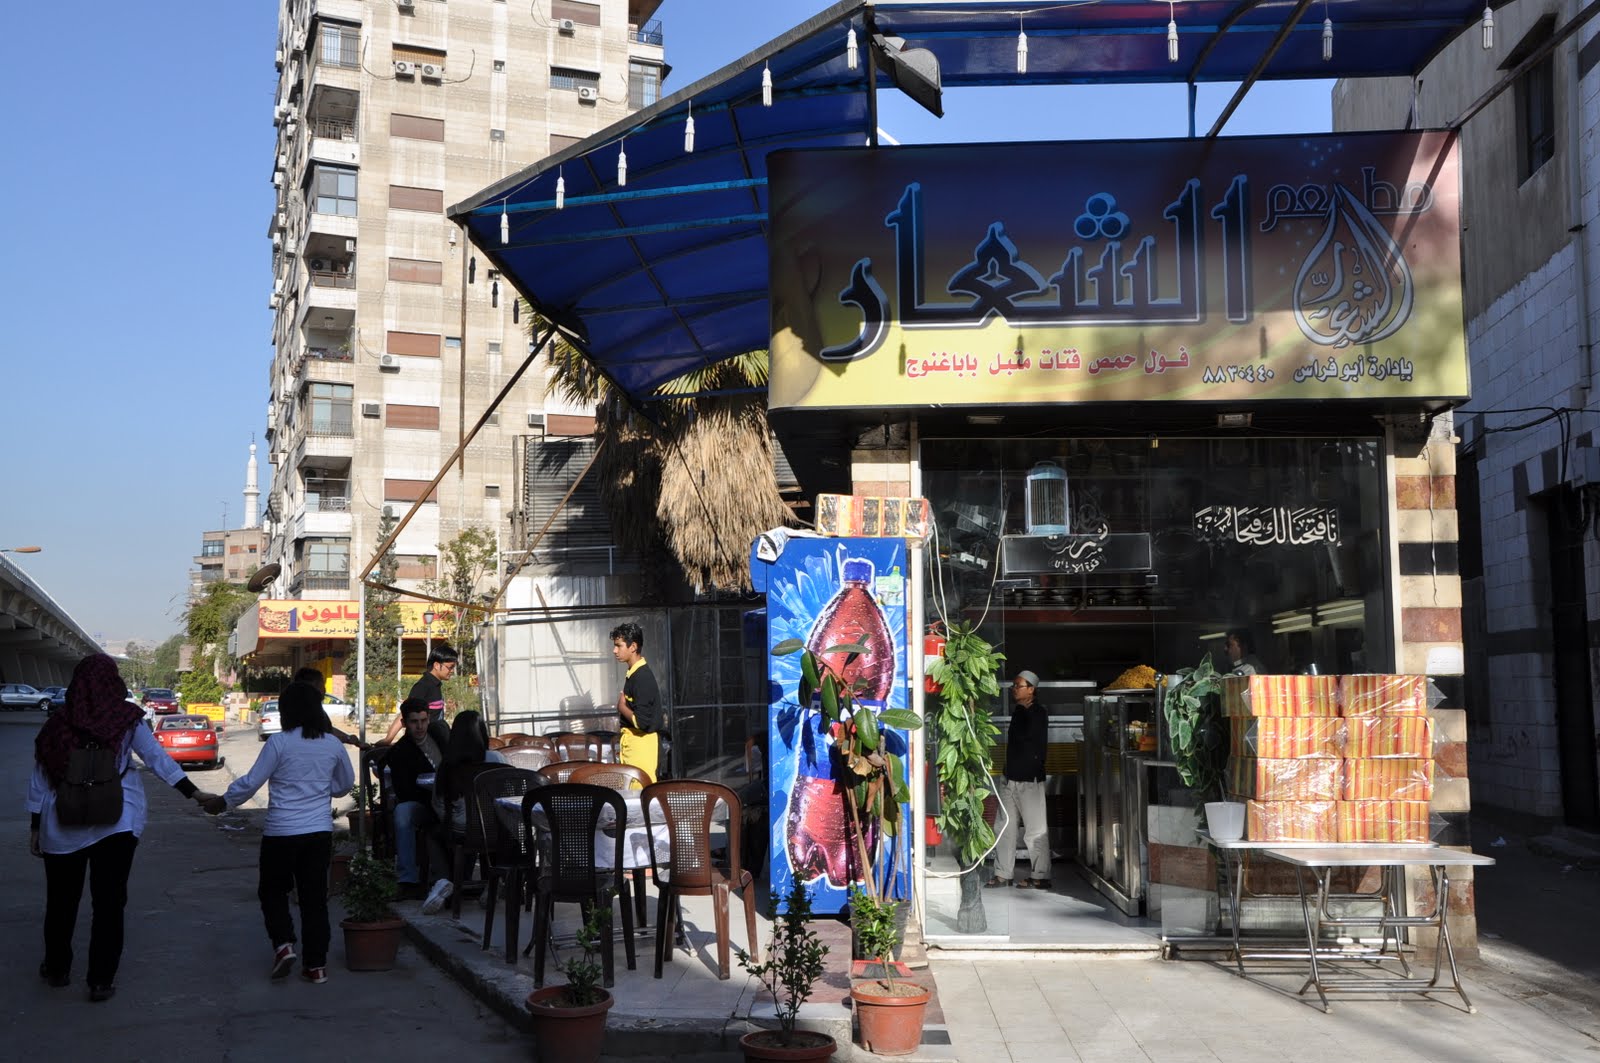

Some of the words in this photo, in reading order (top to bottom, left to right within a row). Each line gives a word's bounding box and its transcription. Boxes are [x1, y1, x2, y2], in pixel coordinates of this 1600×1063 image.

[1260, 166, 1434, 232] مطعم
[820, 174, 1250, 361] الشعار
[988, 349, 1032, 377] متبل
[1087, 352, 1137, 376] حمص
[1143, 346, 1190, 376] فول
[1292, 356, 1339, 383] فراس
